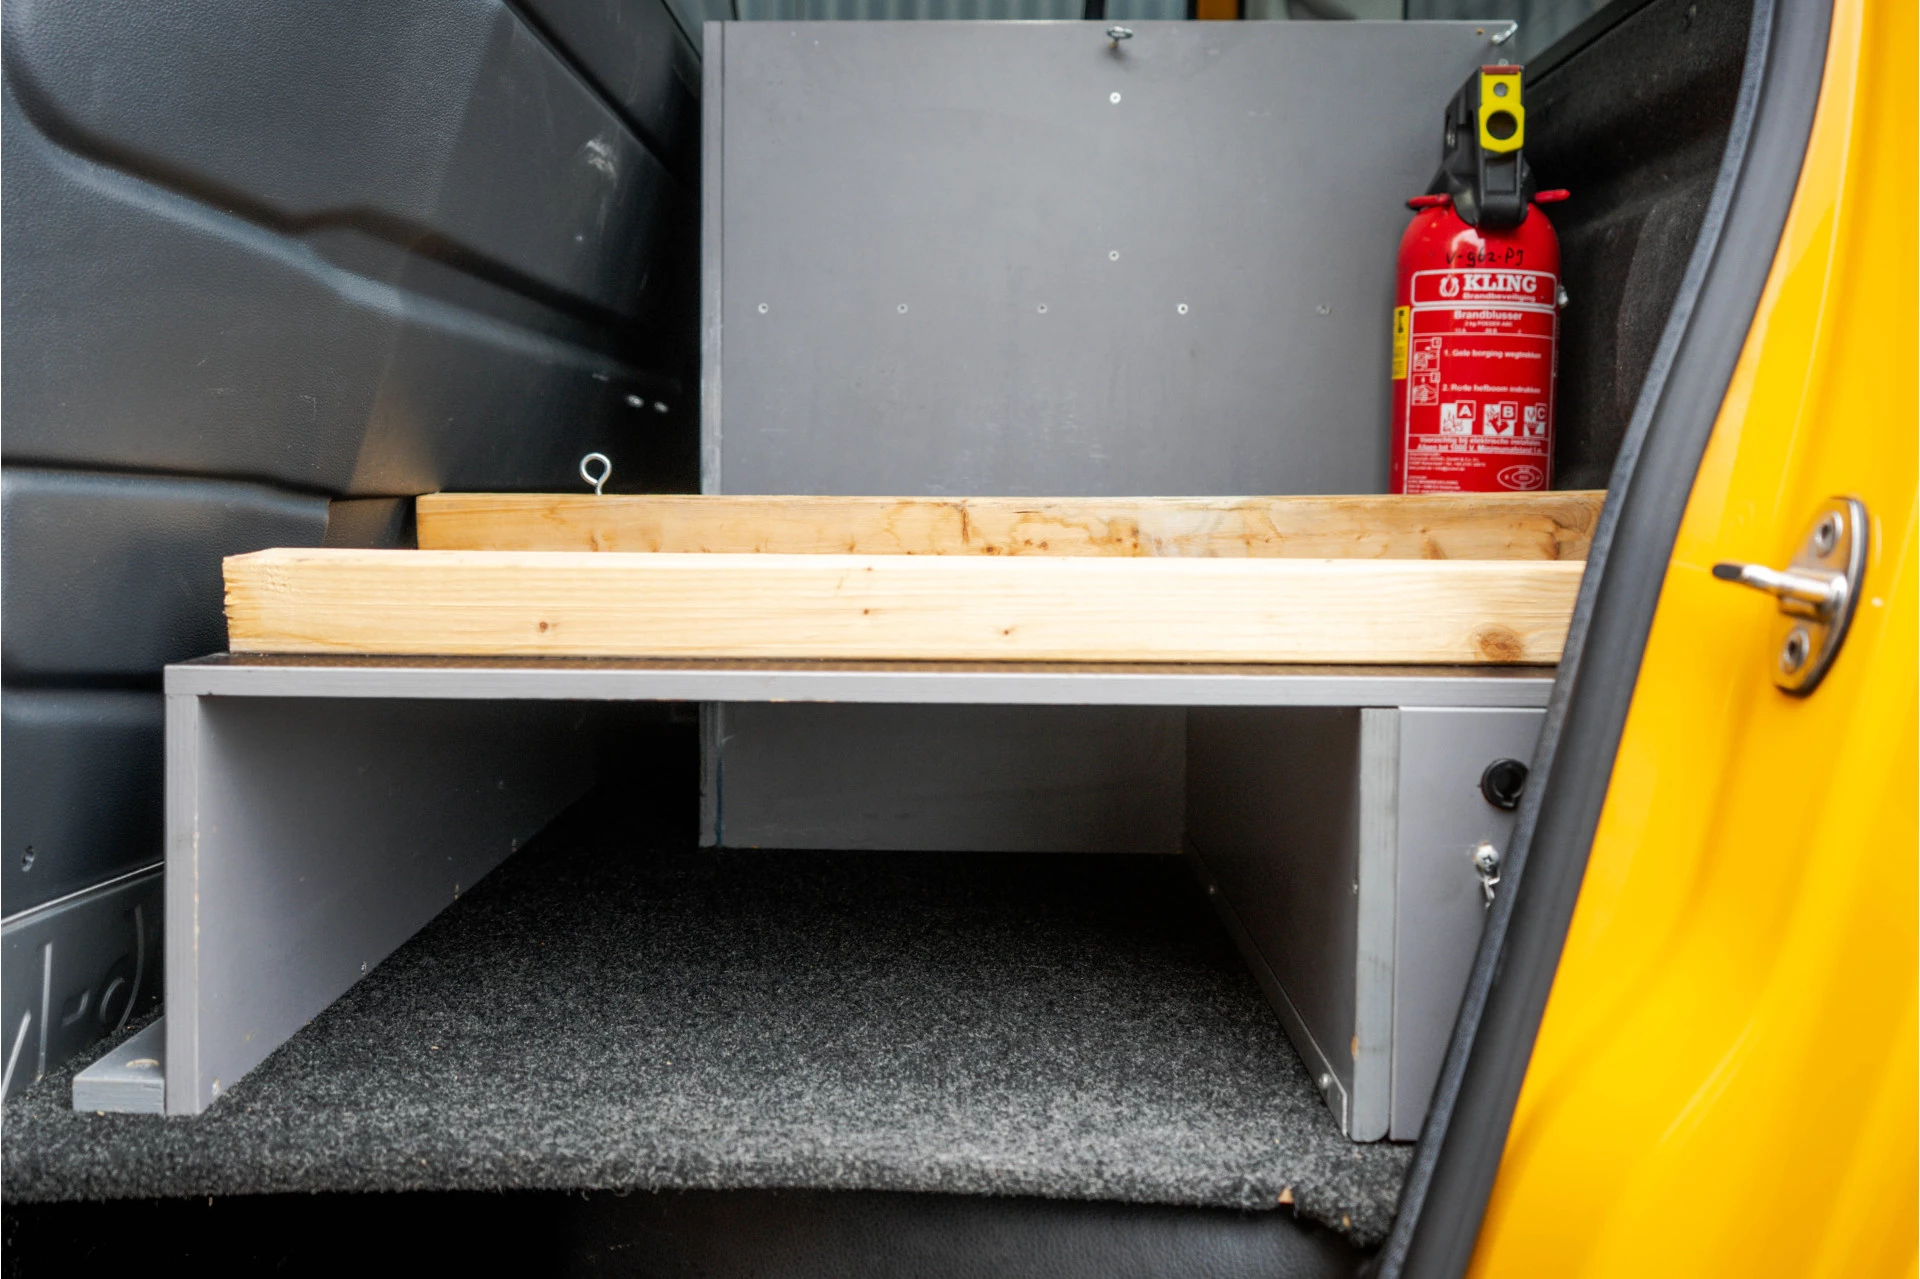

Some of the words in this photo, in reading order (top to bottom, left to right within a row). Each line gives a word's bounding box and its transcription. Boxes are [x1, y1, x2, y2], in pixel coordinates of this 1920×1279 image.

[1463, 273, 1537, 293] KLING
[1463, 292, 1536, 302] Brandbeveiliging
[1453, 309, 1522, 320] Brandblusser
[1452, 349, 1471, 357] Gele
[1472, 349, 1503, 359] borging
[1450, 383, 1472, 392] Rode
[1473, 384, 1508, 393] hefboom
[1459, 405, 1472, 417] A
[1503, 405, 1514, 418] B
[1536, 407, 1546, 419] C
